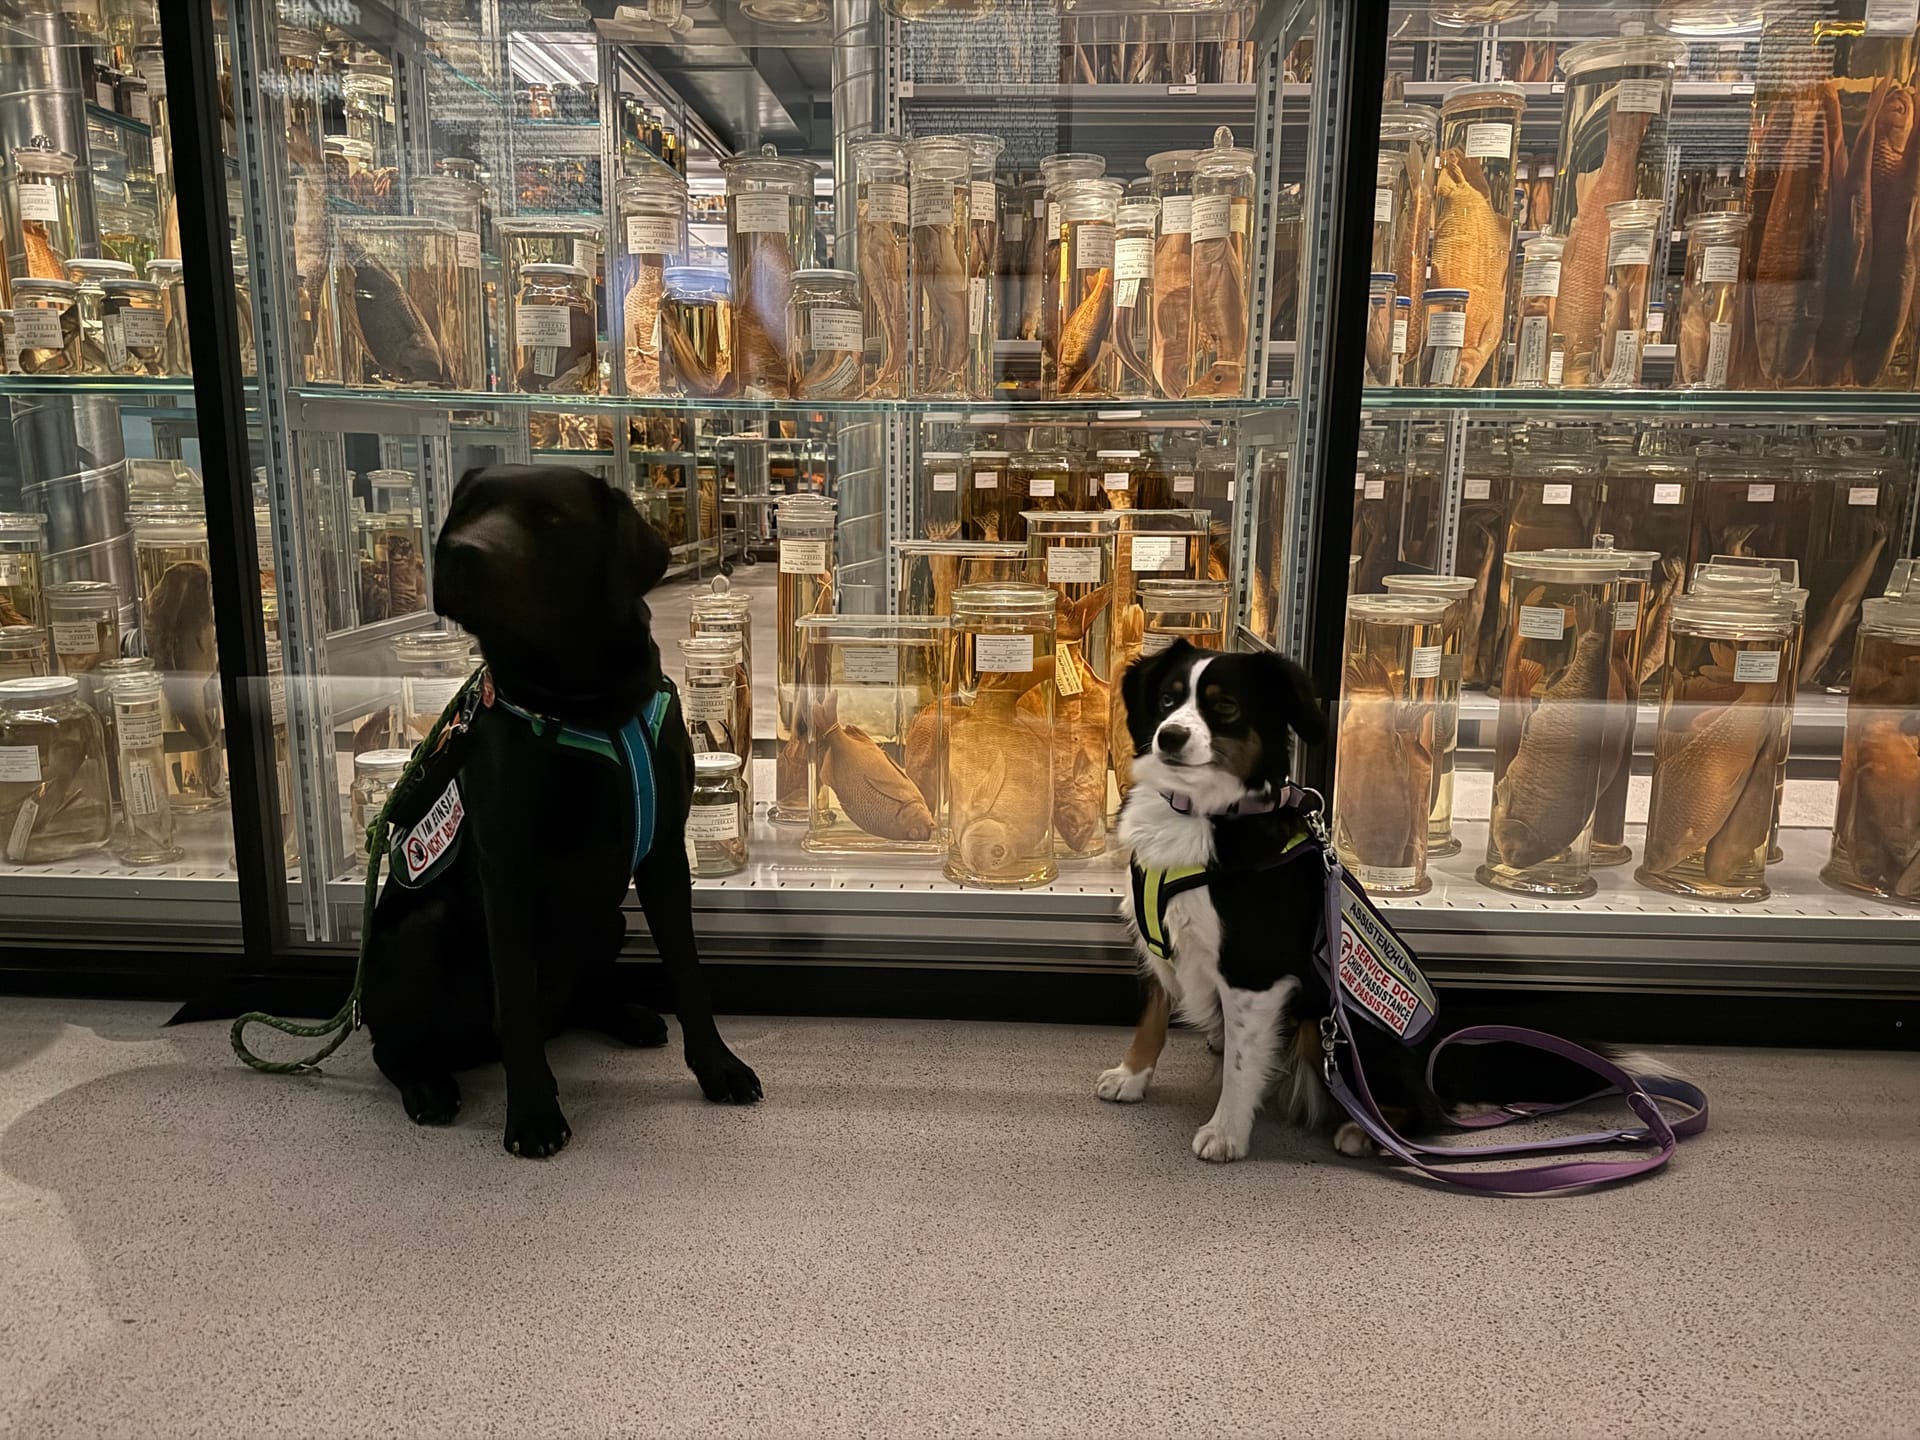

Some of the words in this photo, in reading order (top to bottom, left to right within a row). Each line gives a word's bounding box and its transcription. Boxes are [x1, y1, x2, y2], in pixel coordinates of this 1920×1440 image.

[421, 818, 433, 838] IM
[1349, 902, 1417, 984] ASSISTENZHUND
[1354, 943, 1391, 988] SERVICE
[1391, 983, 1416, 1010] DOG
[1340, 965, 1354, 988] CANE
[1354, 982, 1405, 1033] D'ASSISTENZA
[1347, 954, 1364, 979] CHIEN
[1362, 971, 1411, 1021] D'ASSISTANCE
